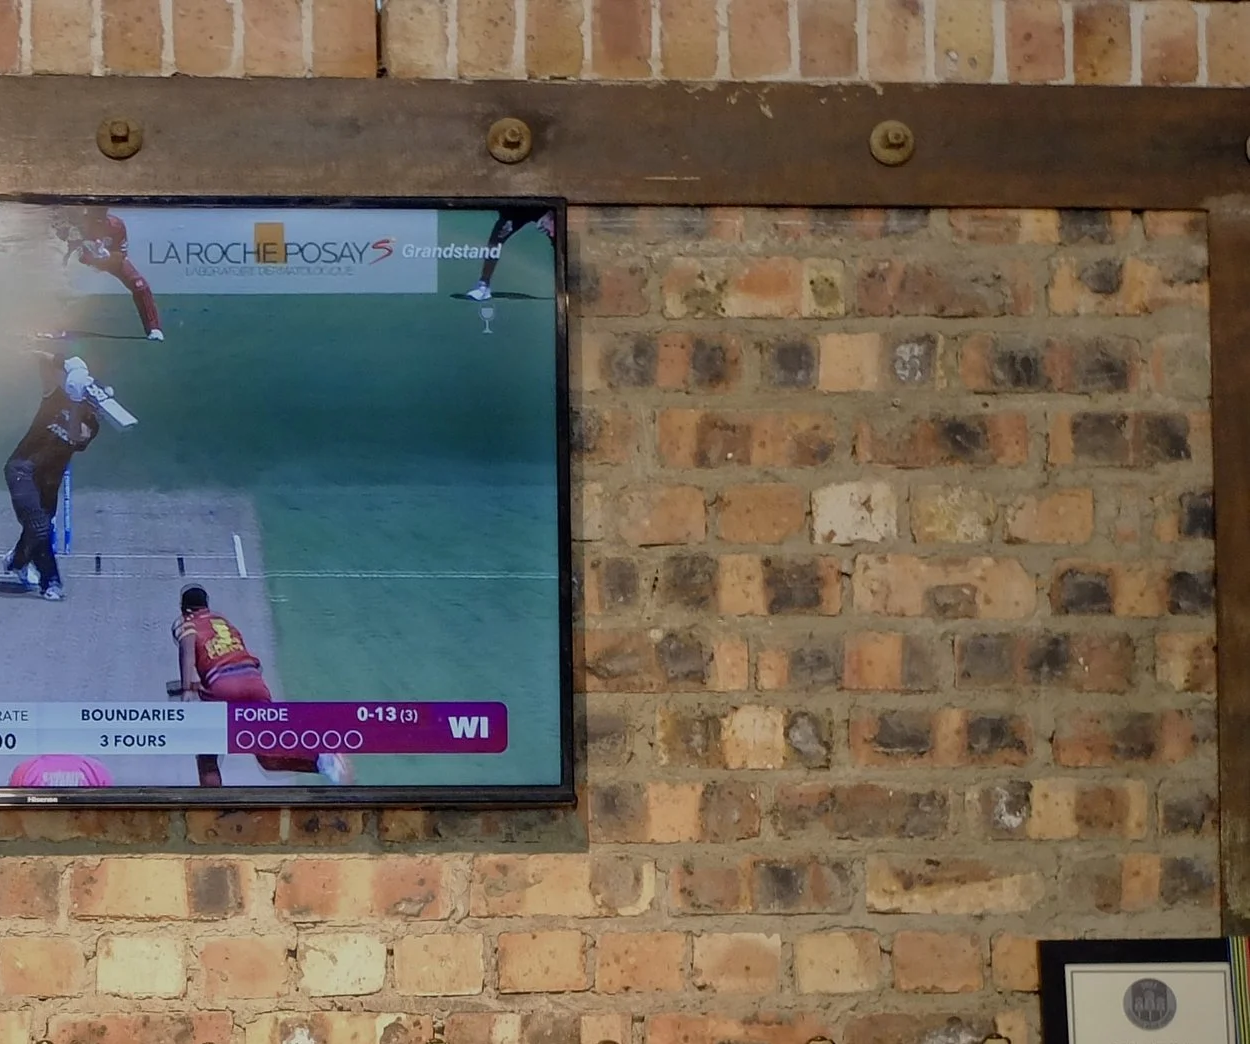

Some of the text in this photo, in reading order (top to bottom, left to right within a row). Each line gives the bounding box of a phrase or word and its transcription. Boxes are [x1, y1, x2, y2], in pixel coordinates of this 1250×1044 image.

[186, 242, 278, 264] ROCHE
[285, 242, 371, 264] POSAY
[402, 243, 502, 260] Grandstand
[81, 708, 185, 722] BOUNDARIES
[235, 707, 418, 723] FORDE 0-13 (3)
[448, 716, 489, 740] WI
[100, 735, 166, 747] 3 FOURS
